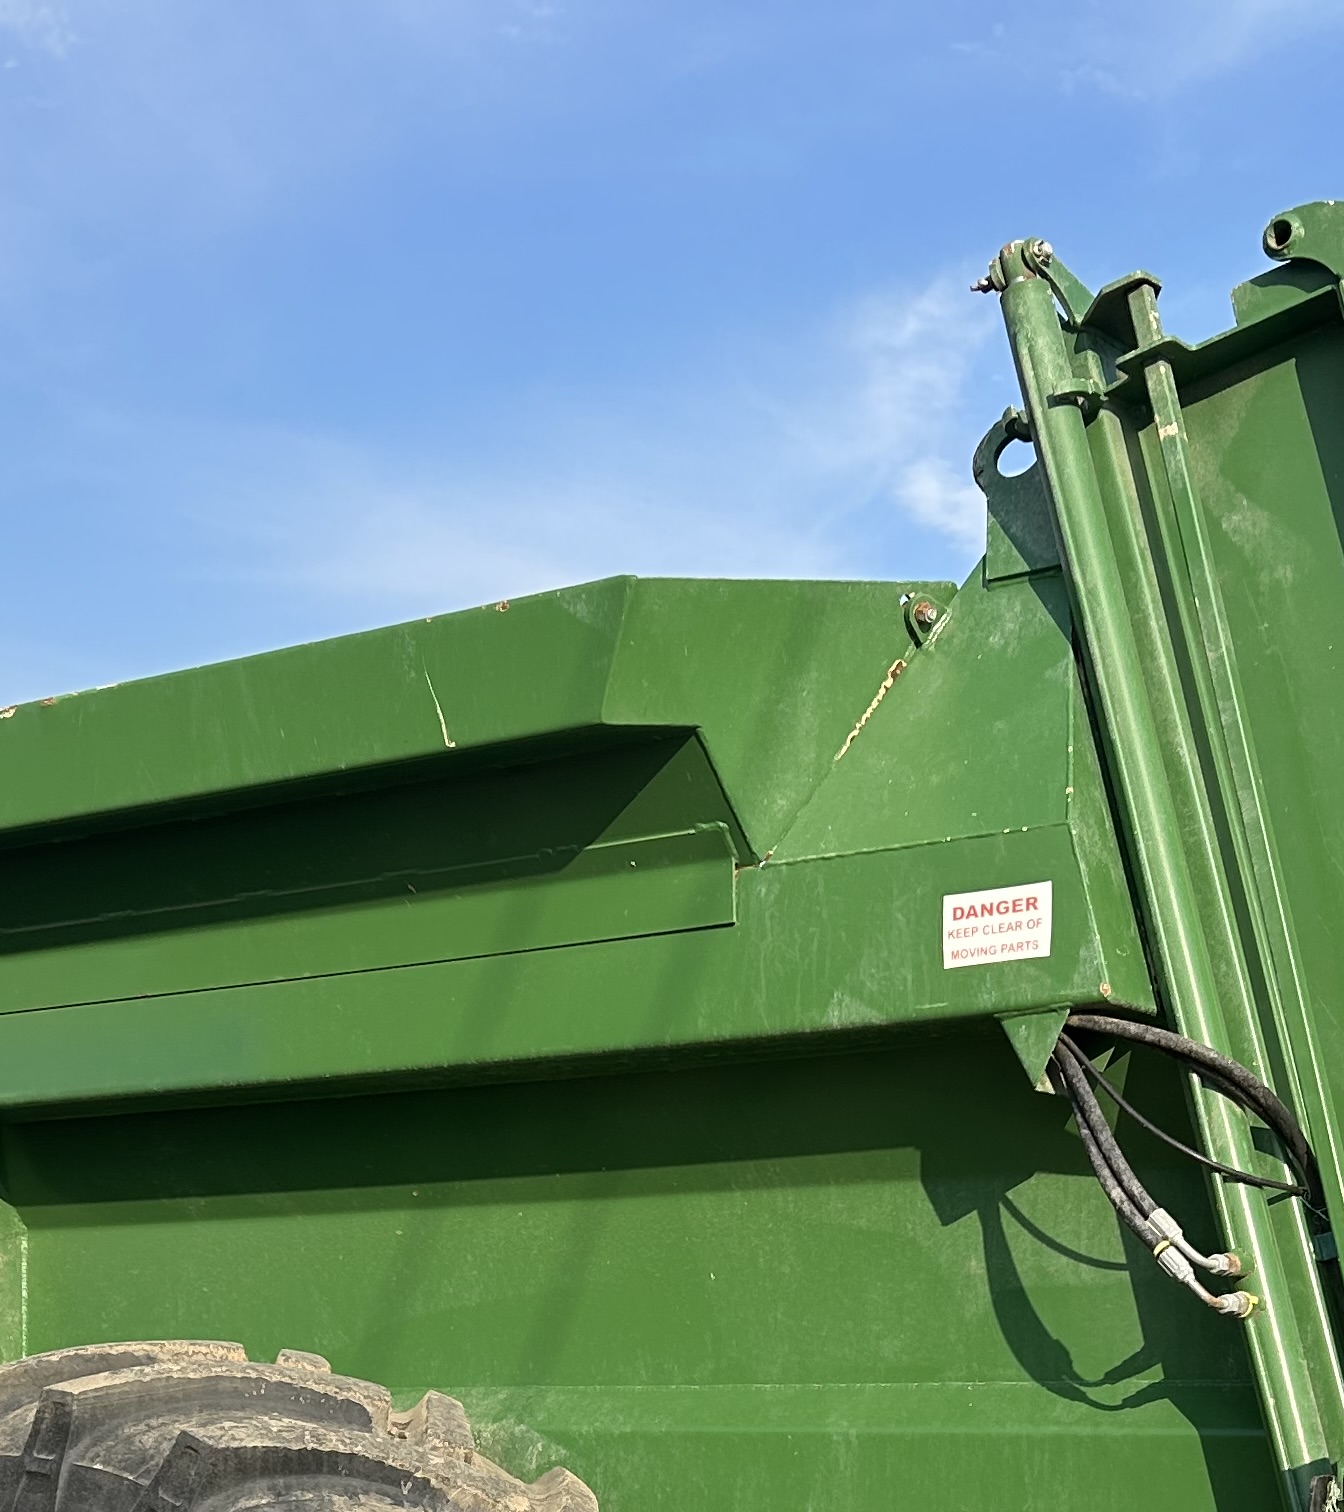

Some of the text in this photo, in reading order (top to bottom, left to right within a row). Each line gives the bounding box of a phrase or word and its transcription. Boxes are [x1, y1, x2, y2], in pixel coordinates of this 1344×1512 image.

[952, 896, 1039, 921] DANGER
[947, 917, 1043, 940] KEEP CLEAR OF
[951, 939, 1039, 960] MOVING PARTS
